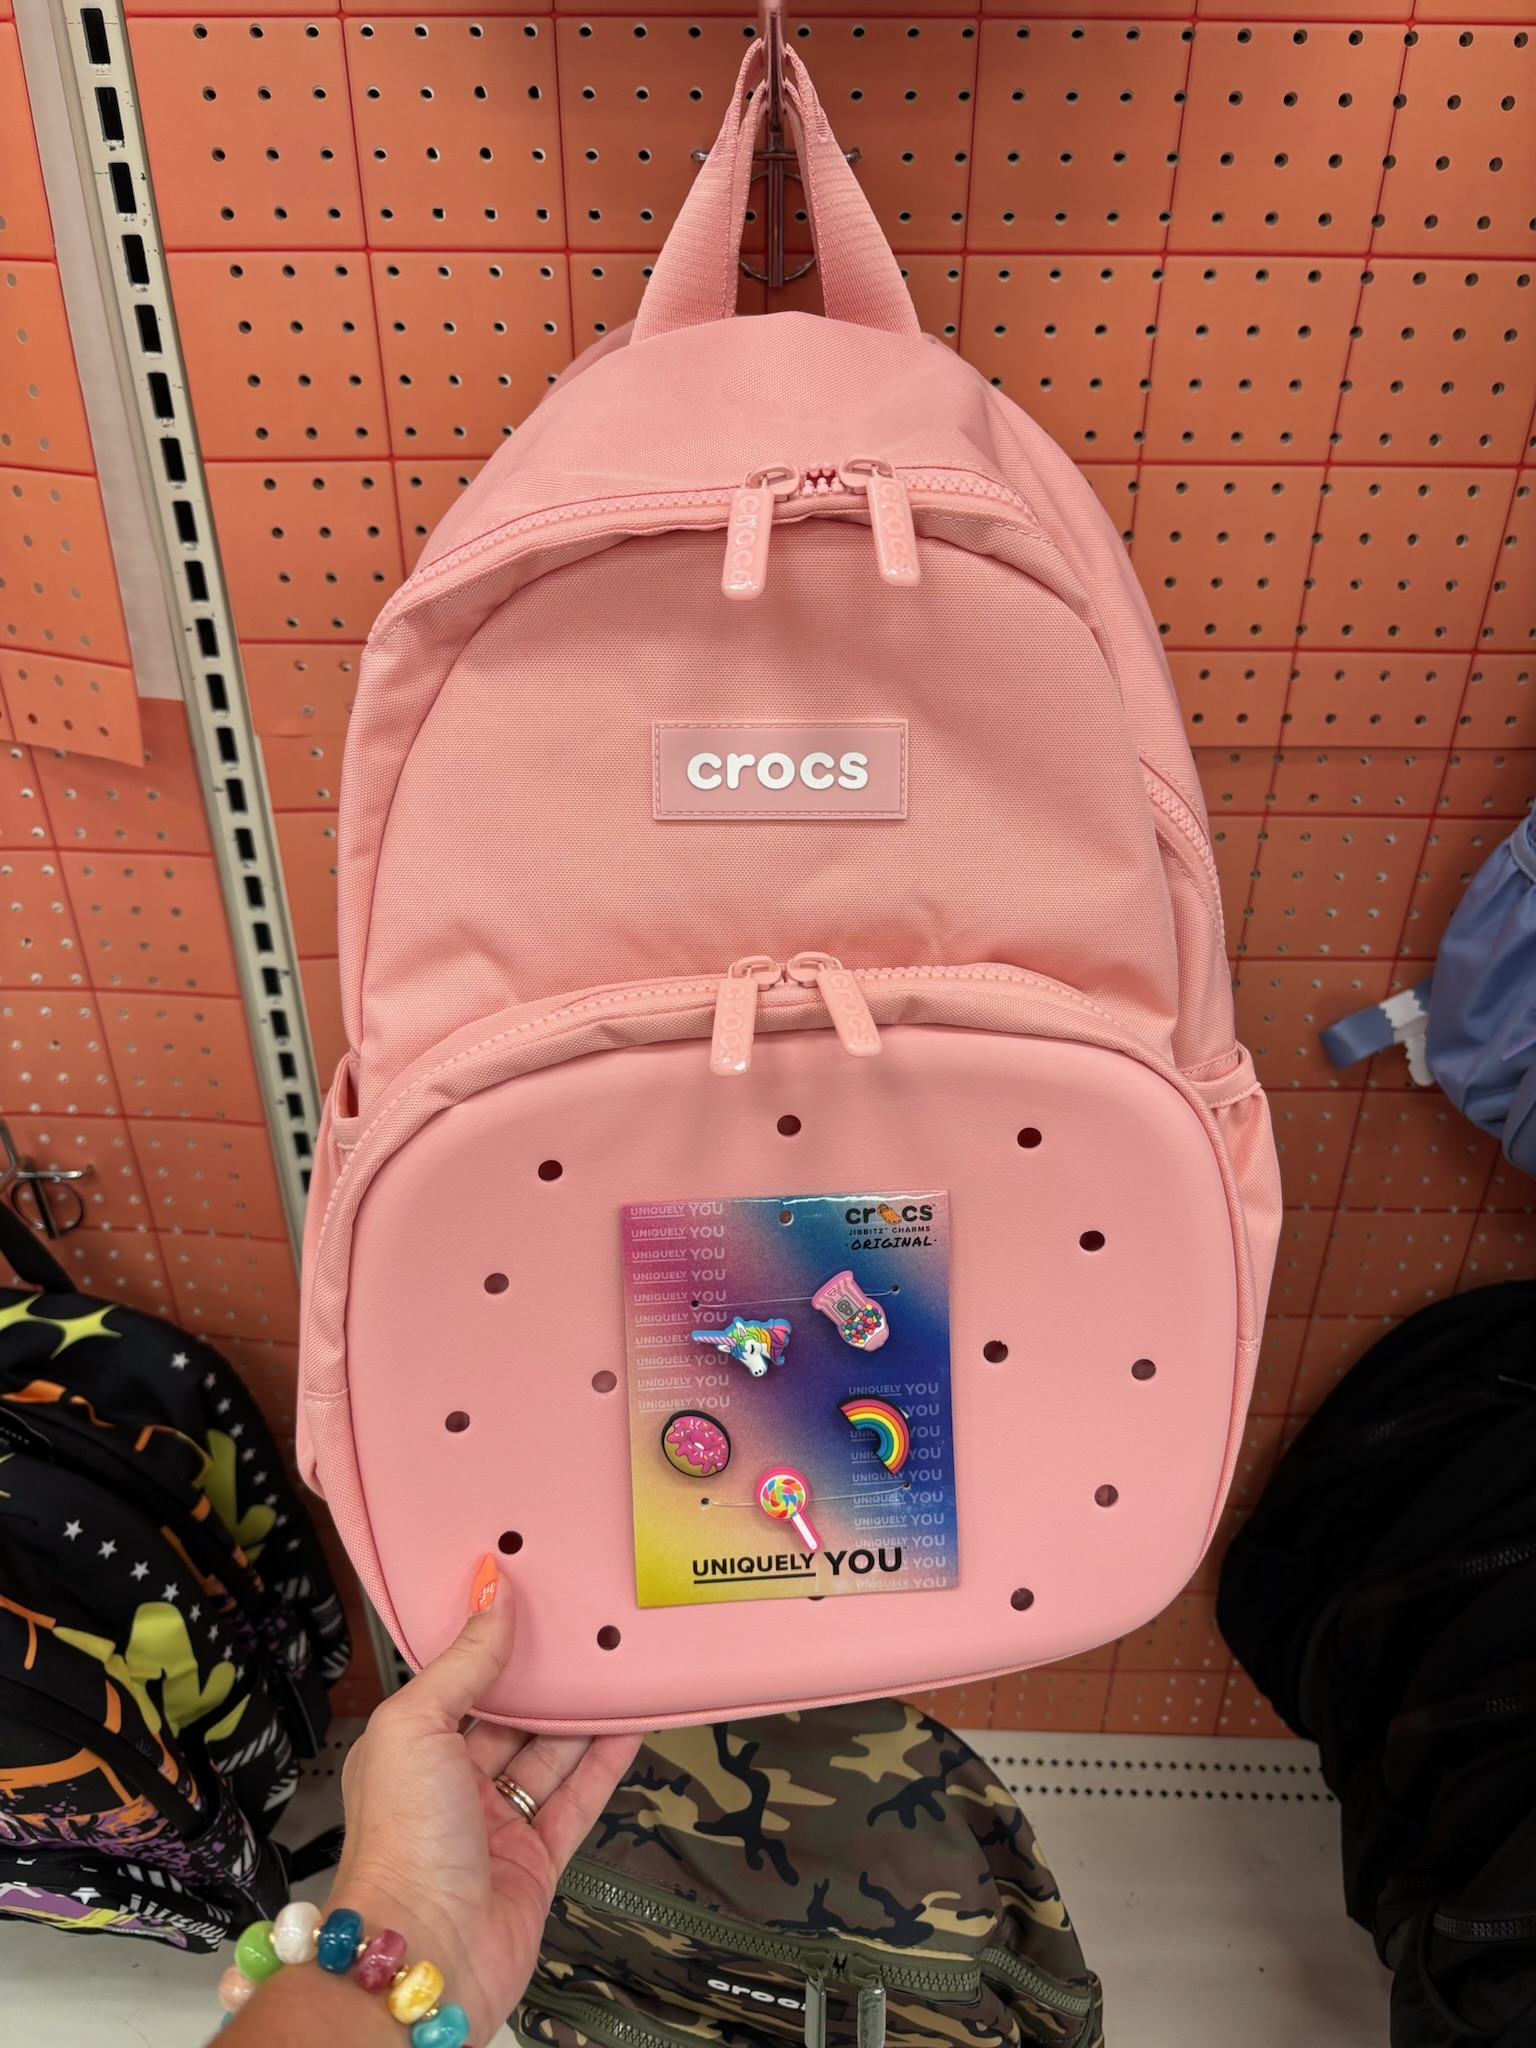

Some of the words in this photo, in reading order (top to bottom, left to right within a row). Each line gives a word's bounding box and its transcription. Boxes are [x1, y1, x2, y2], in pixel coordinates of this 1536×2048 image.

[686, 752, 869, 790] crocs
[630, 1205, 685, 1216] UNIQUELY
[689, 1203, 723, 1216] YOU
[631, 1227, 686, 1238] UNIQUELY
[690, 1225, 724, 1238] YOU
[632, 1249, 687, 1260] UNIQUELY
[690, 1247, 725, 1260] YOU
[633, 1271, 688, 1281] UNIQUELY
[691, 1269, 726, 1281] YOU
[633, 1292, 688, 1303] UNIQUELY
[692, 1291, 727, 1302] YOU
[635, 1313, 688, 1324] UNIQUELY
[693, 1312, 728, 1324] YOU
[636, 1334, 690, 1345] UNIQUELY
[637, 1356, 691, 1366] UNIQUELY
[694, 1353, 729, 1366] YOU
[638, 1377, 691, 1388] UNIQUELY
[695, 1374, 730, 1387] YOU
[848, 1384, 902, 1395] UNIQUELY
[905, 1382, 939, 1395] YOU
[639, 1398, 693, 1409] UNIQUELY
[696, 1396, 730, 1409] YOU
[906, 1404, 940, 1417] YOU
[909, 1447, 941, 1460] YOU
[908, 1469, 942, 1482] YOU
[854, 1493, 906, 1504] UNIQUELY
[909, 1491, 943, 1504] YOU
[855, 1515, 907, 1526] UNIQUELY
[911, 1513, 944, 1526] YOU
[856, 1537, 907, 1548] UNIQUELY
[912, 1535, 945, 1548] YOU
[693, 1553, 815, 1577] UNIQUELY
[824, 1547, 903, 1576] YOU
[913, 1556, 946, 1568] YOU
[914, 1577, 947, 1588] YOU
[707, 1979, 806, 2012] croc
